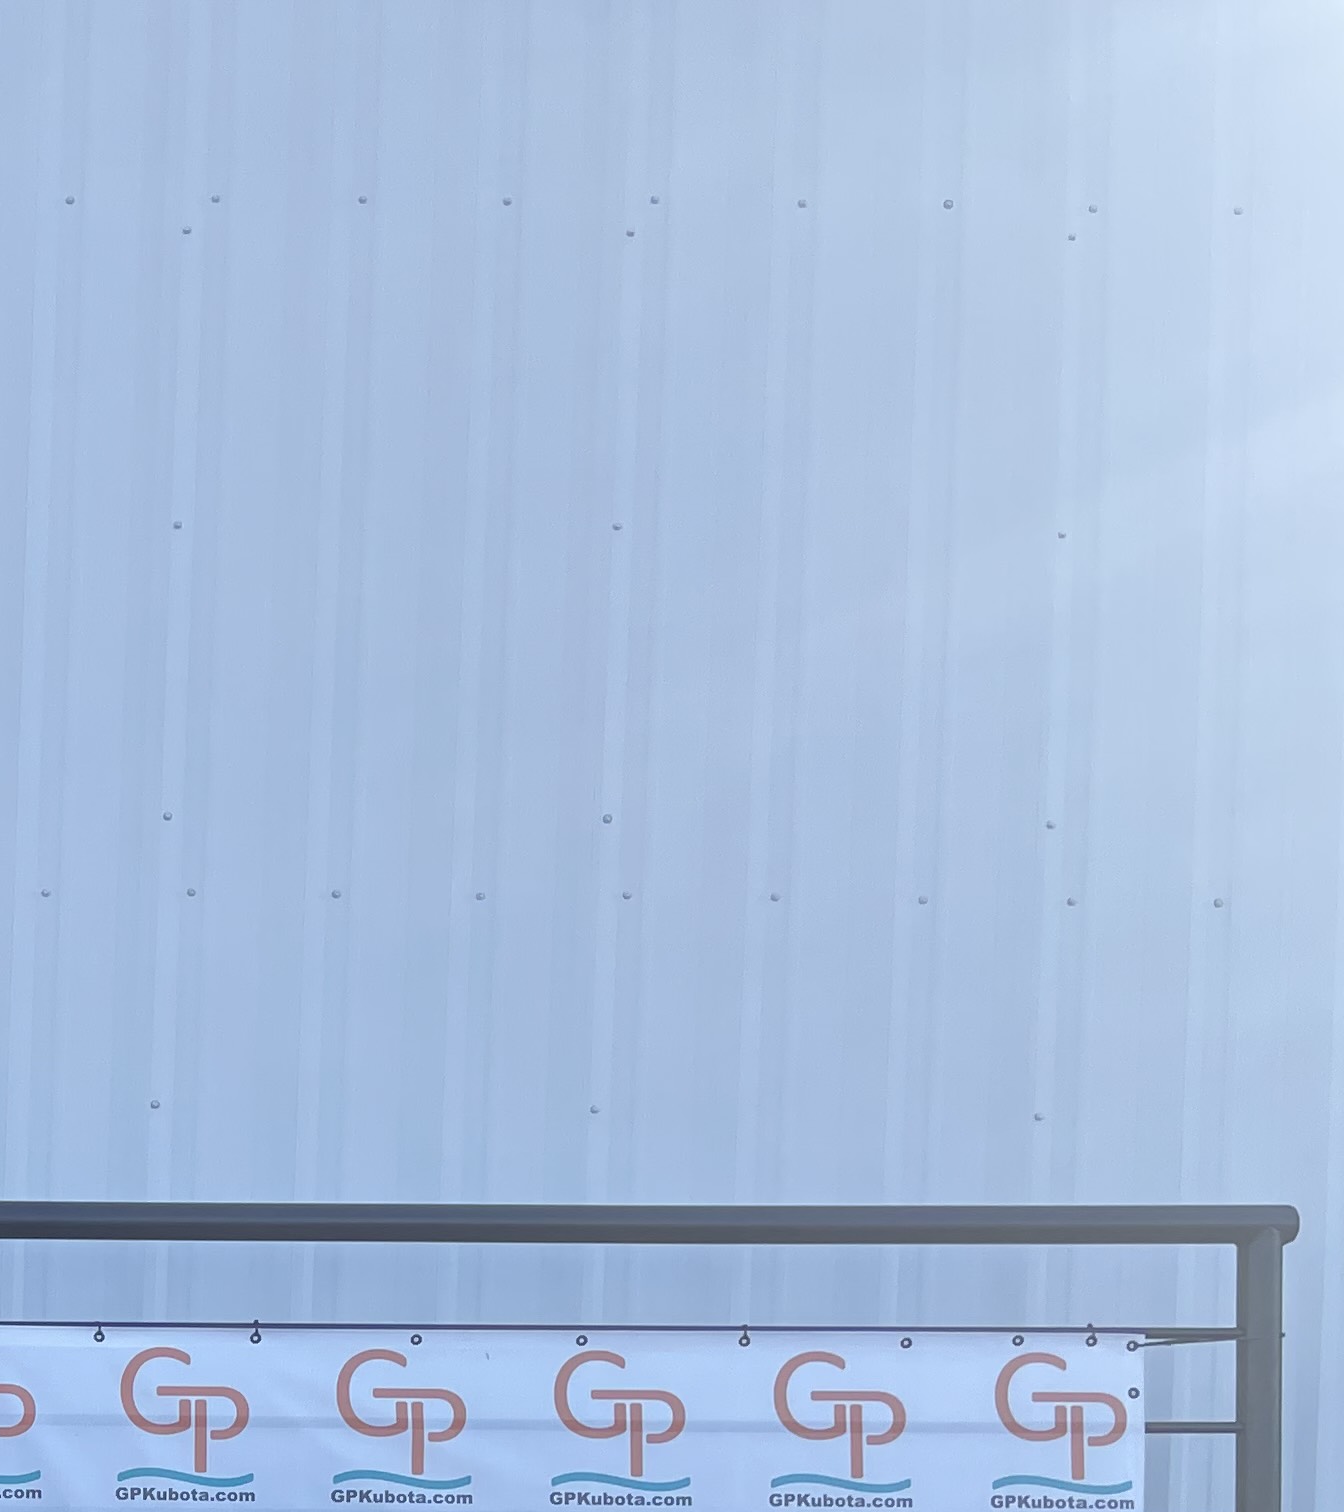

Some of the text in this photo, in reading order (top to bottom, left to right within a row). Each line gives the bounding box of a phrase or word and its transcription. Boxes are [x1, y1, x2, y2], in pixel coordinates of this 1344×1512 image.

[121, 1347, 249, 1472] GP
[337, 1349, 466, 1475] GP
[554, 1351, 685, 1476] GP
[774, 1351, 906, 1478] GP
[995, 1352, 1126, 1480] GP
[116, 1487, 255, 1501] GPKubota.com
[331, 1490, 472, 1504] GPKubota.com
[550, 1492, 692, 1506] GPKubota.com
[769, 1494, 912, 1508] GPKubota.com
[990, 1495, 1135, 1509] GPKubota.com
